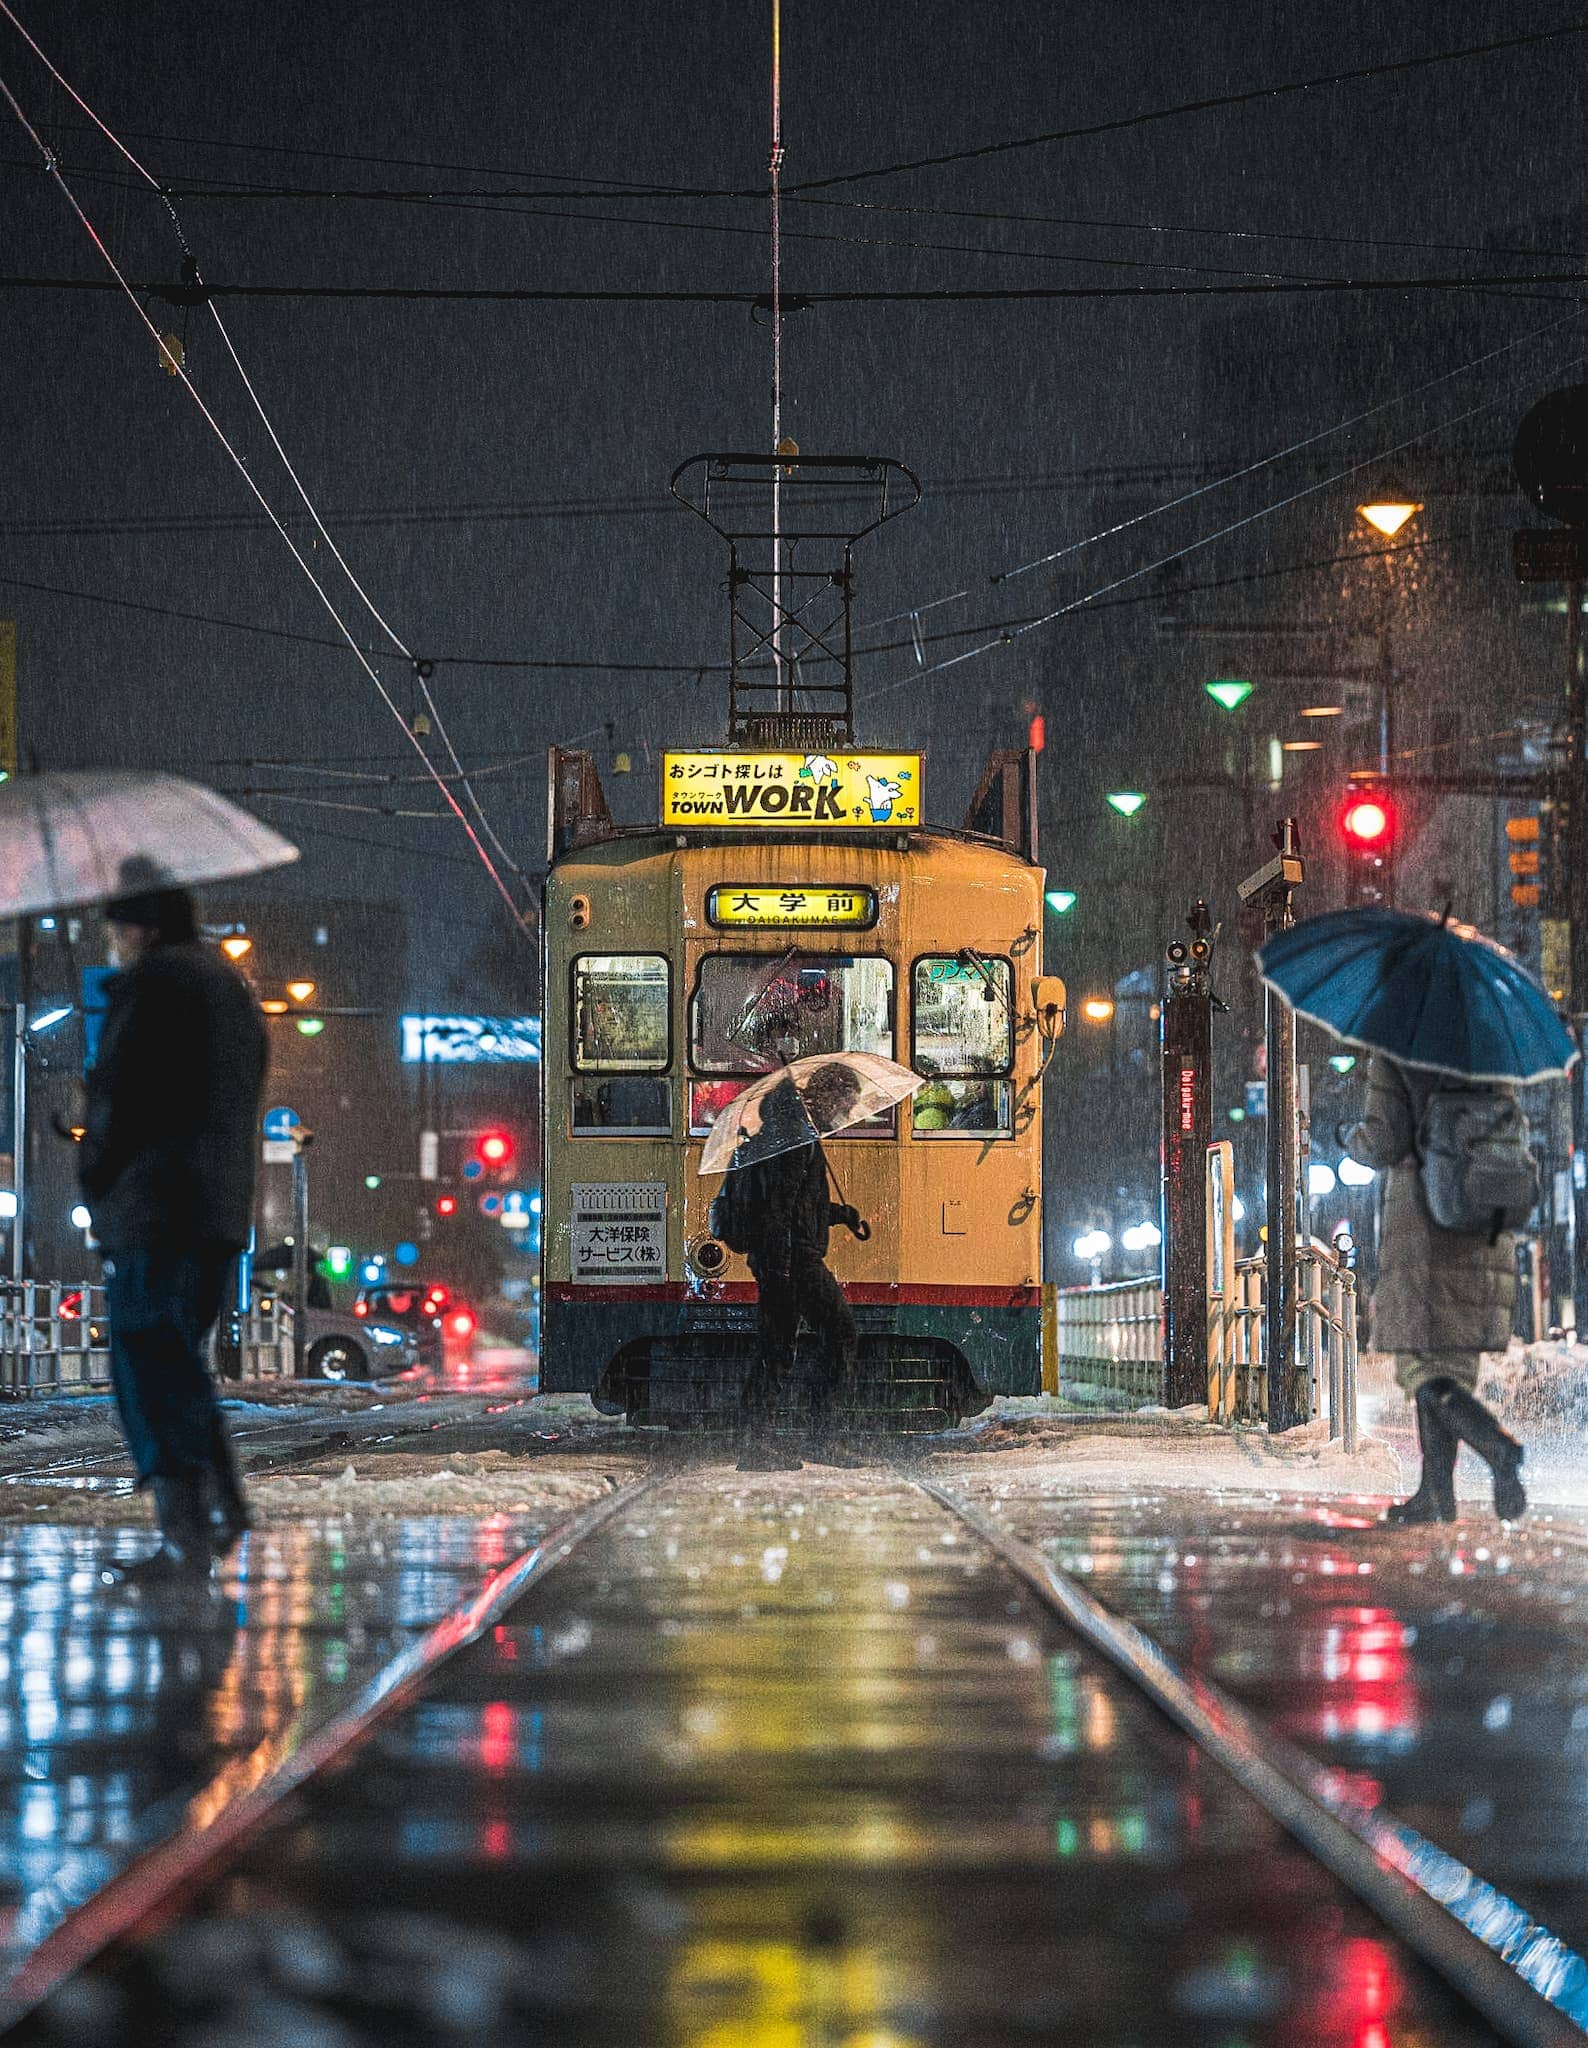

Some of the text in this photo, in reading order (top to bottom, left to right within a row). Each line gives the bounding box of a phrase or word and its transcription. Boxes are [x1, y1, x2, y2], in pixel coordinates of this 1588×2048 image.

[669, 764, 783, 779] おシゴト探しは
[671, 785, 847, 820] TOWN WORK
[672, 791, 722, 800] タウンワーク
[732, 893, 855, 912] 大学前
[747, 916, 838, 924] DAIGAKUMAE
[589, 1226, 650, 1243] 大洋保険
[579, 1246, 661, 1262] サービス(株)
